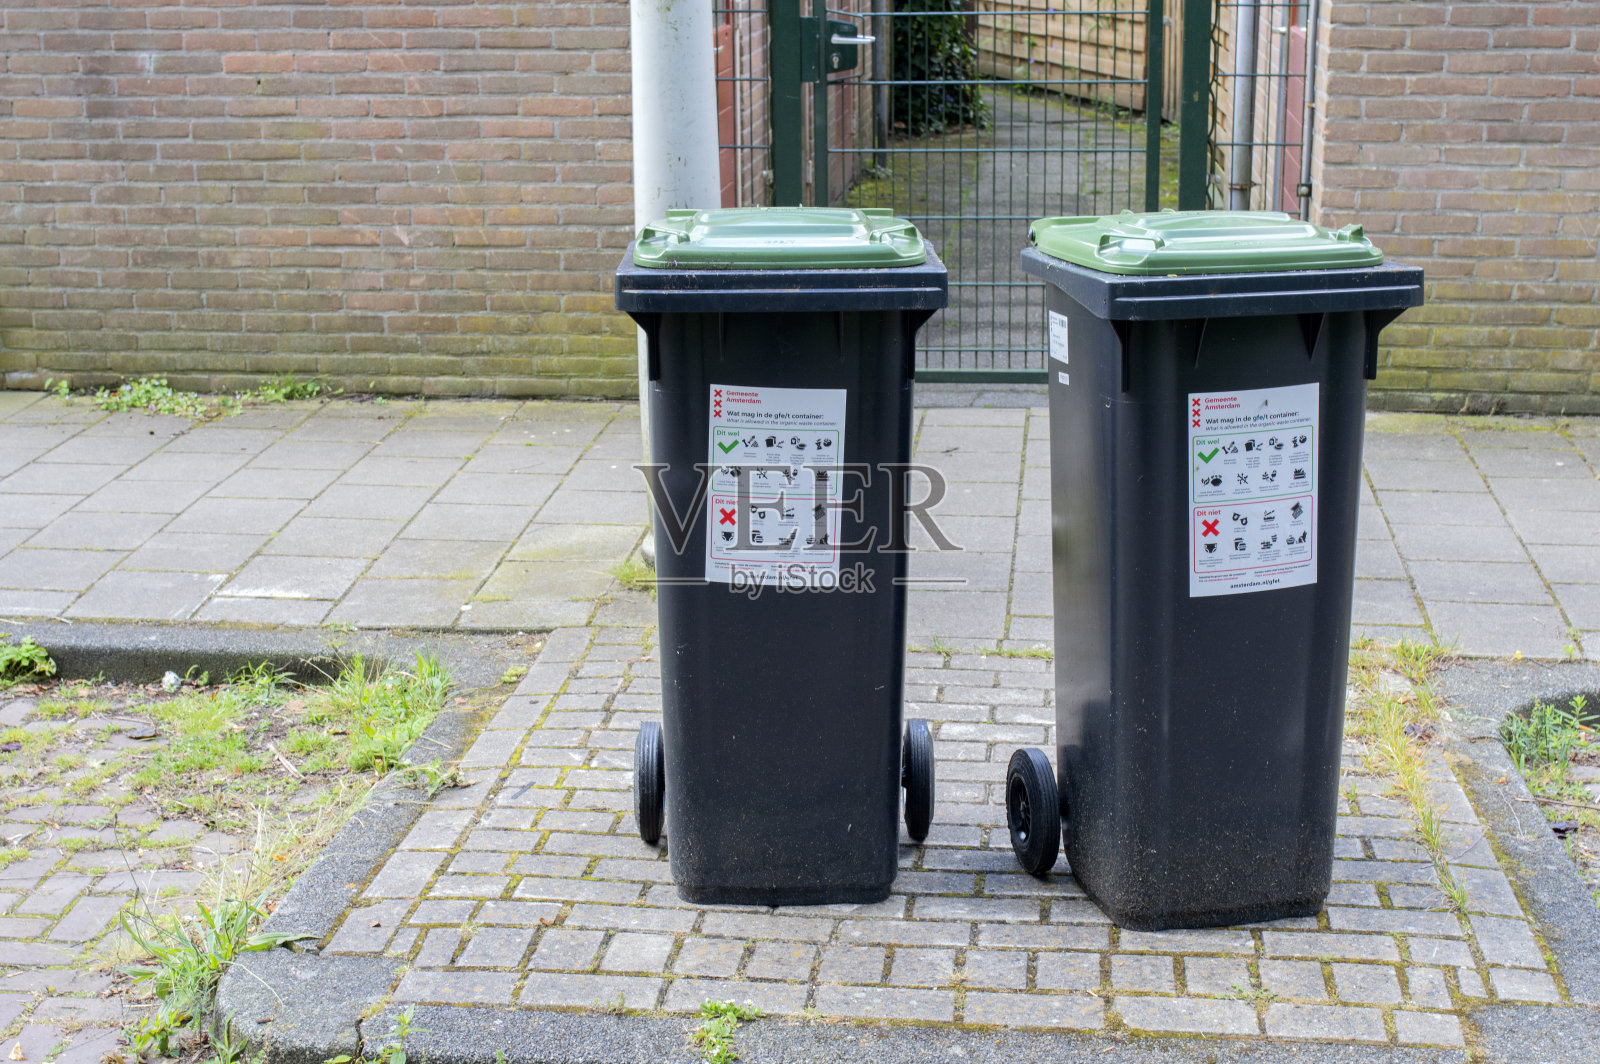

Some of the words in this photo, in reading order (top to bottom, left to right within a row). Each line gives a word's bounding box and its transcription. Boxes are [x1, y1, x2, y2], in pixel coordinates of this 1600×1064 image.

[726, 390, 759, 398] Gemeente
[726, 397, 762, 405] Amsterdam
[1204, 396, 1237, 404] Gemeente
[1204, 403, 1241, 411] Amsterdam
[764, 411, 773, 419] de
[774, 412, 791, 420] gfe/t
[1220, 417, 1234, 425] mag
[1253, 413, 1268, 422] gfe/t
[1258, 420, 1276, 428] organic
[1196, 438, 1206, 446] Dit
[1207, 438, 1220, 446] wel
[1197, 509, 1207, 517] Dit
